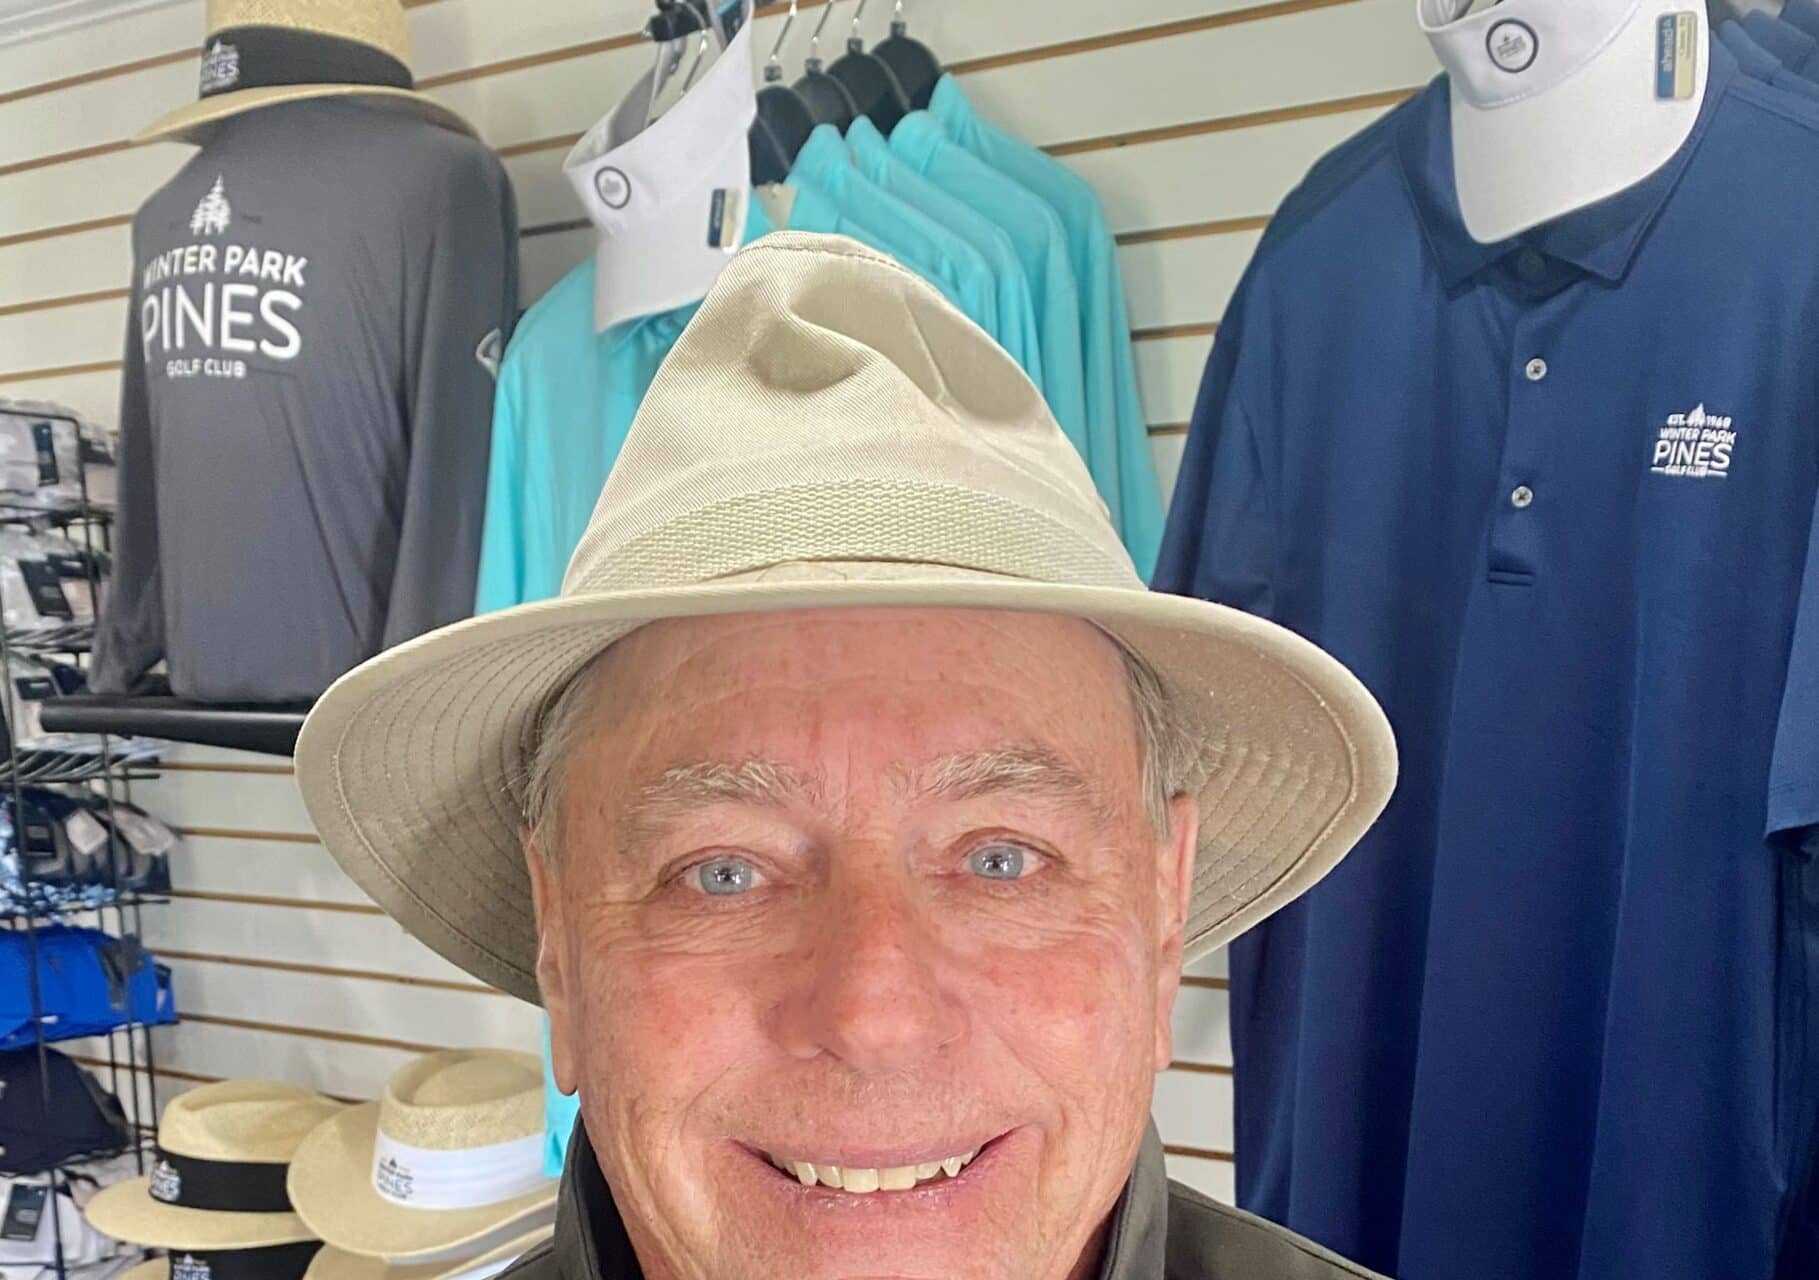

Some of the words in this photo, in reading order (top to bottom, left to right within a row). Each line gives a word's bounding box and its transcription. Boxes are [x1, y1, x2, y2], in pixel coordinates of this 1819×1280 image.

[224, 245, 308, 287] PARK
[142, 282, 303, 363] PINES
[166, 358, 202, 379] GOLF
[203, 358, 247, 379] CLUB
[1660, 427, 1701, 441] WINTER
[1701, 429, 1737, 446] PARK
[1653, 439, 1733, 470] PINES
